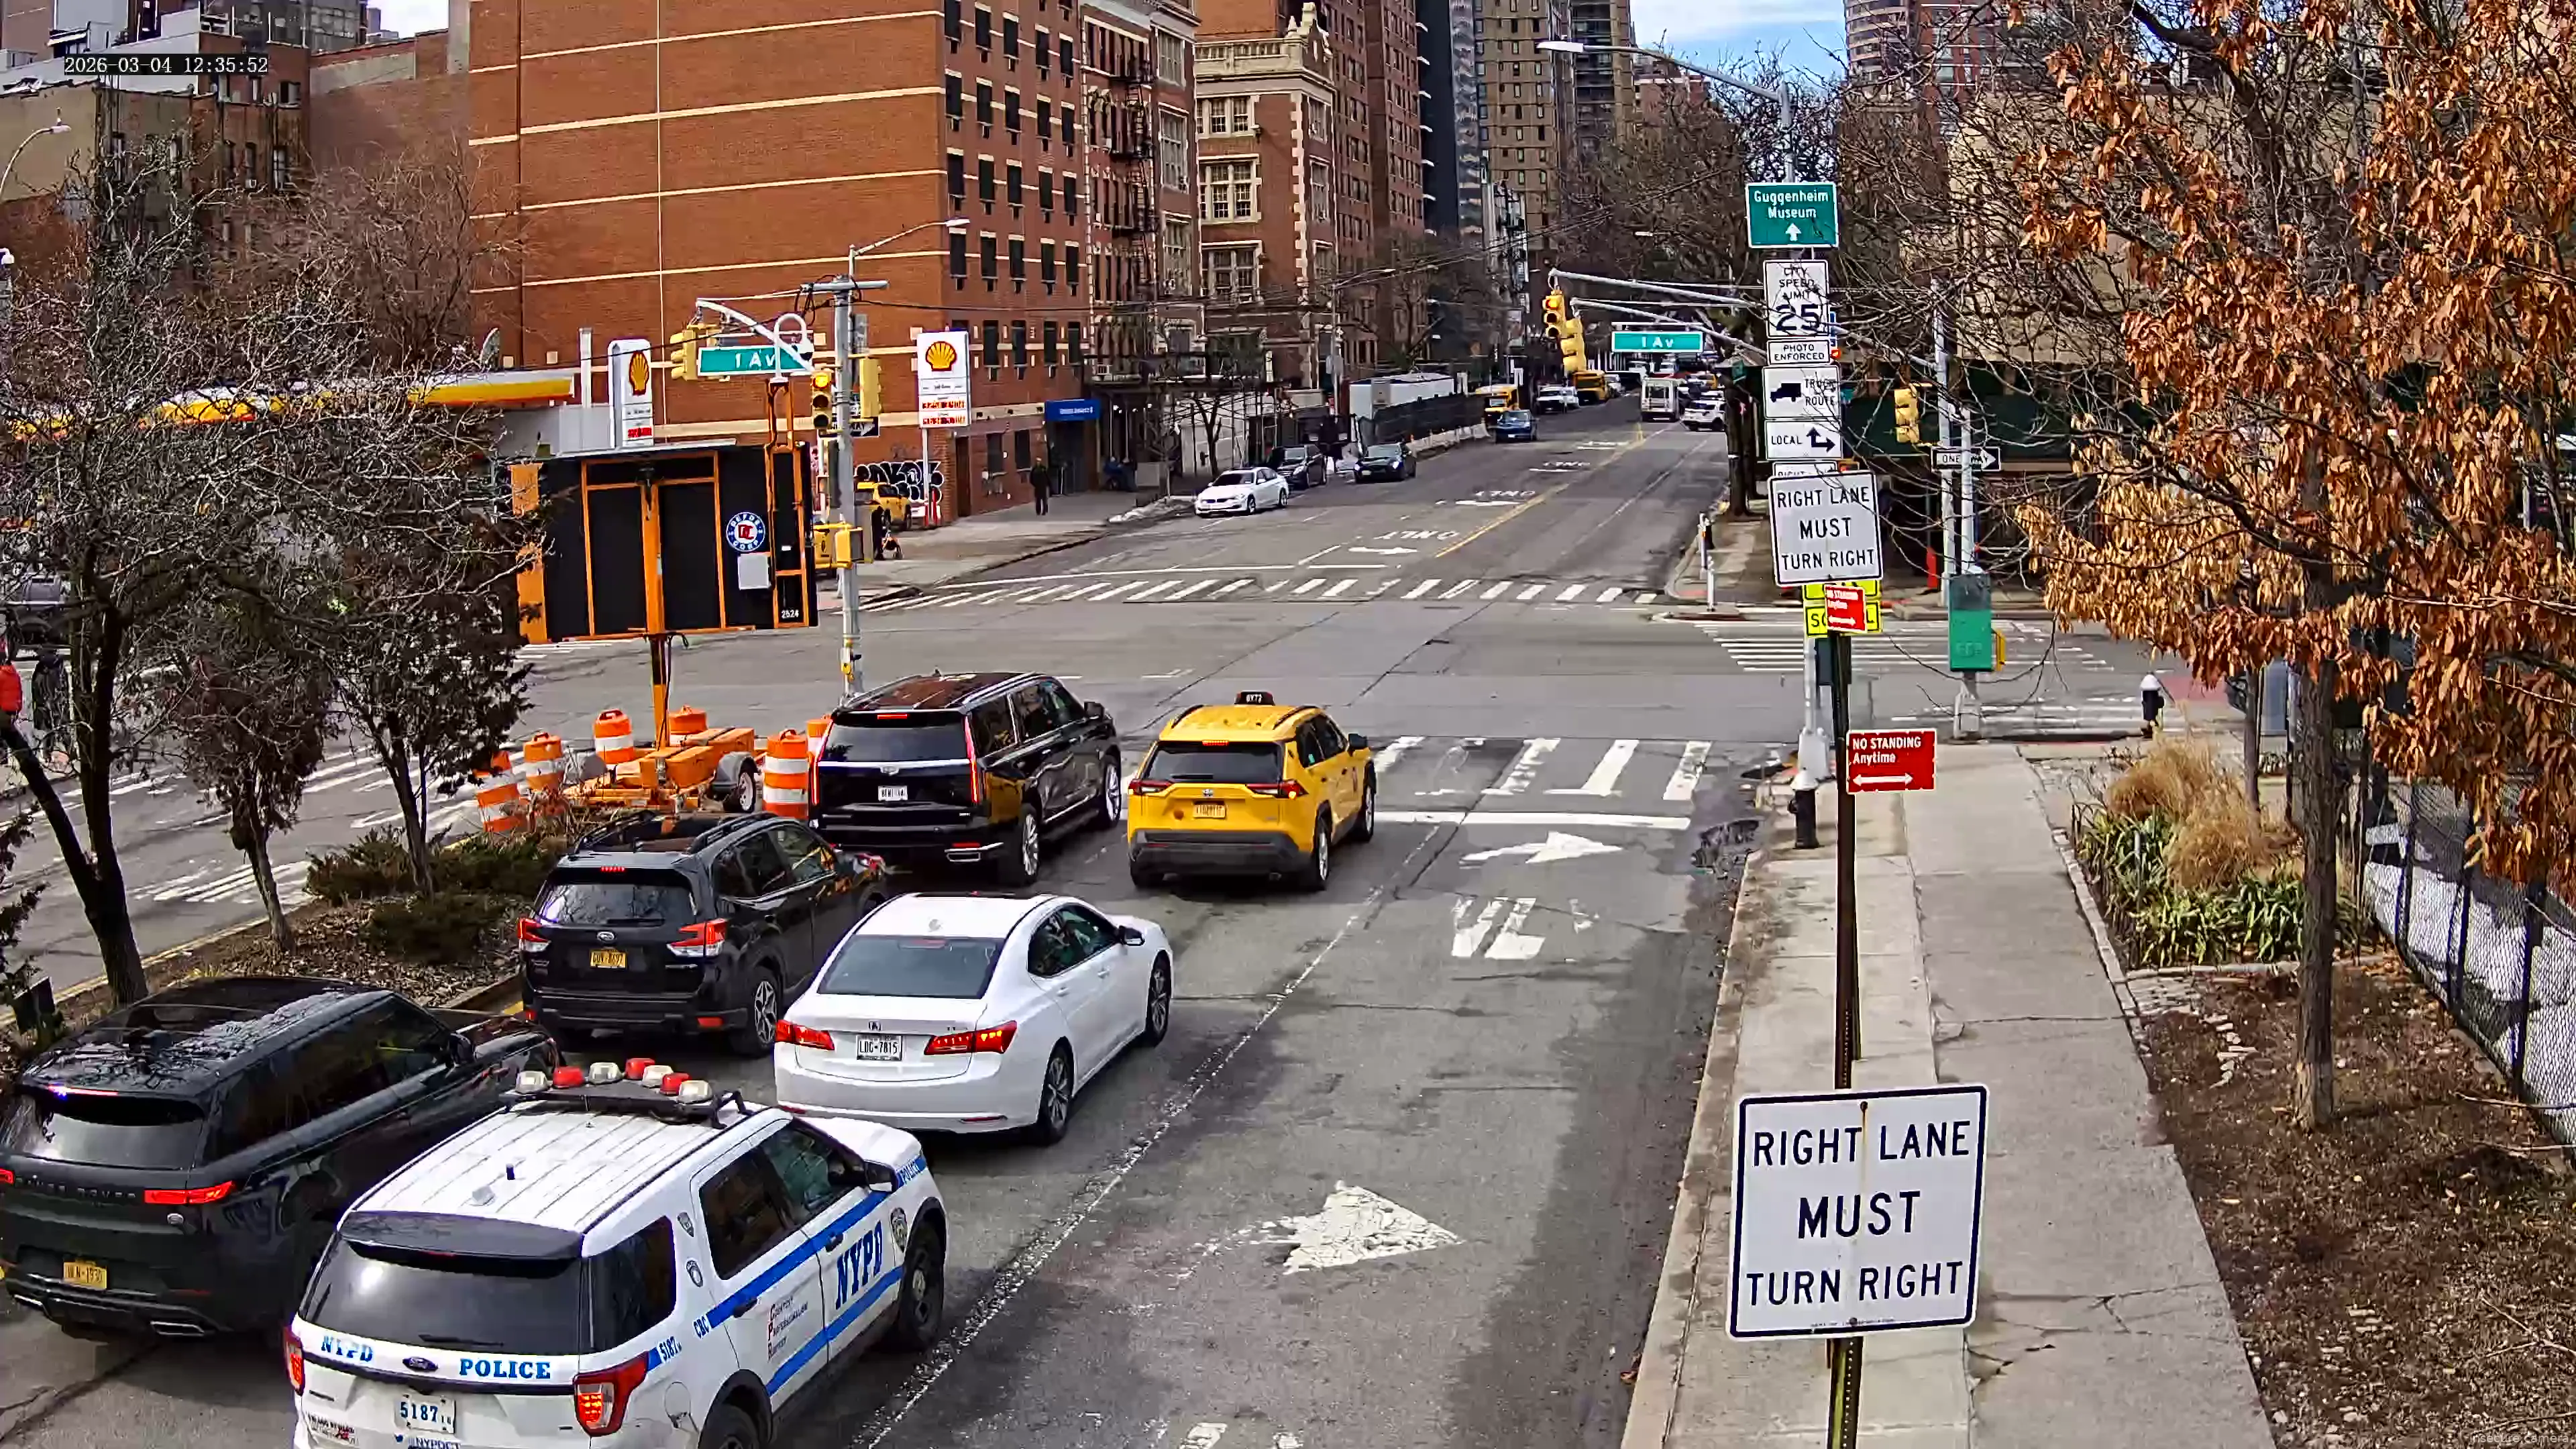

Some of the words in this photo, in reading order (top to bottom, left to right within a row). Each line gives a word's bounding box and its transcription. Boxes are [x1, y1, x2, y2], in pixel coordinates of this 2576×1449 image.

[1754, 189, 1829, 205] Guggenheim
[1768, 207, 1817, 219] Museum
[1776, 304, 1820, 331] 25
[1641, 336, 1647, 347] 1
[1652, 336, 1674, 348] Av
[1783, 343, 1815, 352] PHOTO
[735, 353, 741, 368] 1
[749, 352, 775, 368] Av
[1774, 352, 1825, 361] ENFORCED
[1771, 435, 1803, 445] LOCAL
[1778, 490, 1823, 508] RIGHT
[1830, 486, 1870, 504] LANE
[1800, 517, 1851, 539] MUST
[1782, 552, 1823, 570] TURN
[1830, 549, 1875, 568] RIGHT
[1852, 738, 1868, 750] NO
[1870, 737, 1922, 749] STANDING
[1853, 751, 1896, 766] Anytime
[1754, 1127, 1862, 1167] RIGHT
[1880, 1120, 1970, 1160] LANE
[1798, 1191, 1921, 1239] MUST
[836, 1220, 882, 1309] NYPD
[1746, 1269, 1840, 1306] TURN
[1859, 1261, 1963, 1301] RIGHT
[321, 1336, 374, 1362] NYPD
[460, 1358, 551, 1379] POLICE
[400, 1401, 438, 1422] 5187
